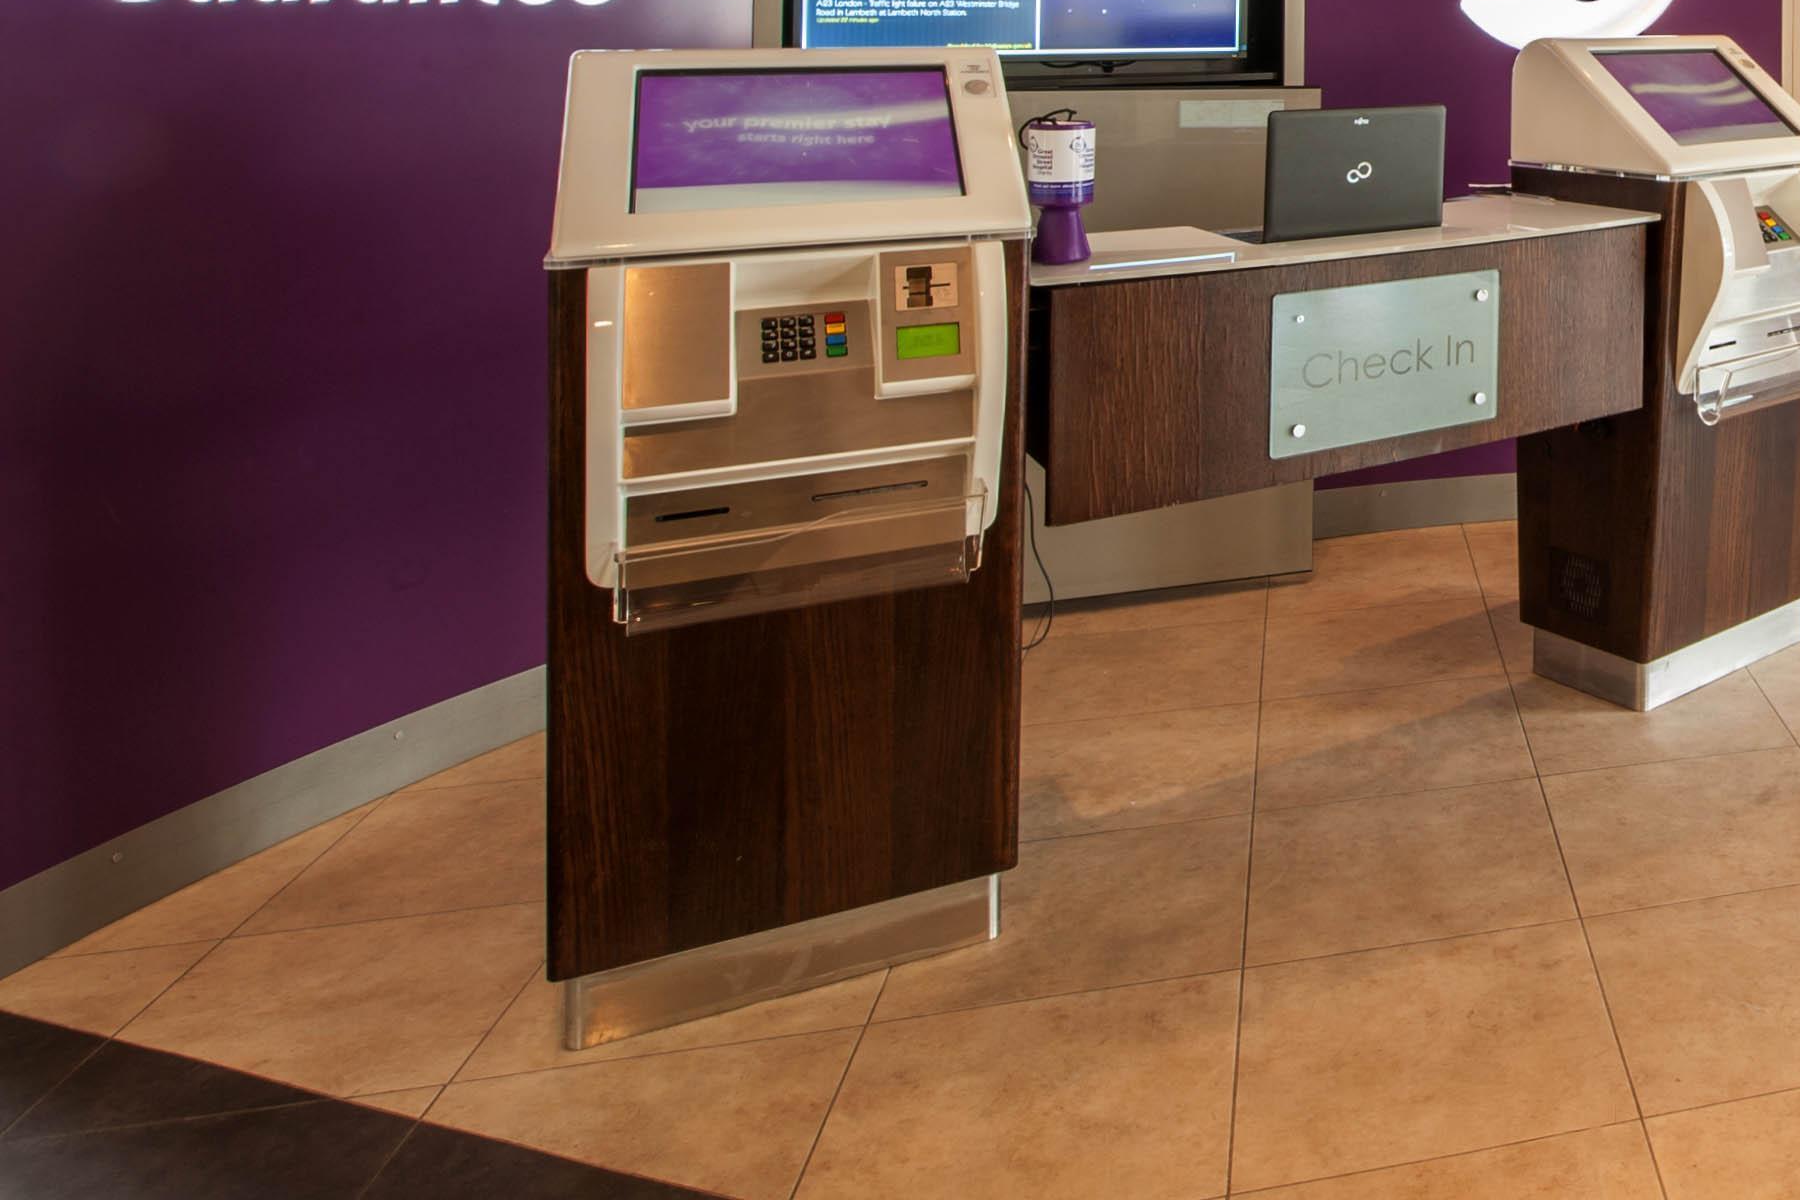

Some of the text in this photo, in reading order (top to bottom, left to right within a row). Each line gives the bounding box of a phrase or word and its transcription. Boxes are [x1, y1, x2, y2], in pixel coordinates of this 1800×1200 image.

[834, 0, 863, 8] London
[869, 0, 890, 8] Traffic
[956, 0, 997, 8] Westminster
[998, 0, 1020, 9] Bridge
[816, 9, 837, 17] Road
[845, 9, 877, 17] Lambeth
[887, 9, 919, 17] Lambeth
[920, 9, 941, 17] North
[682, 114, 893, 133] your premier stay
[737, 132, 875, 146] starts right here
[1302, 335, 1475, 390] Check In
